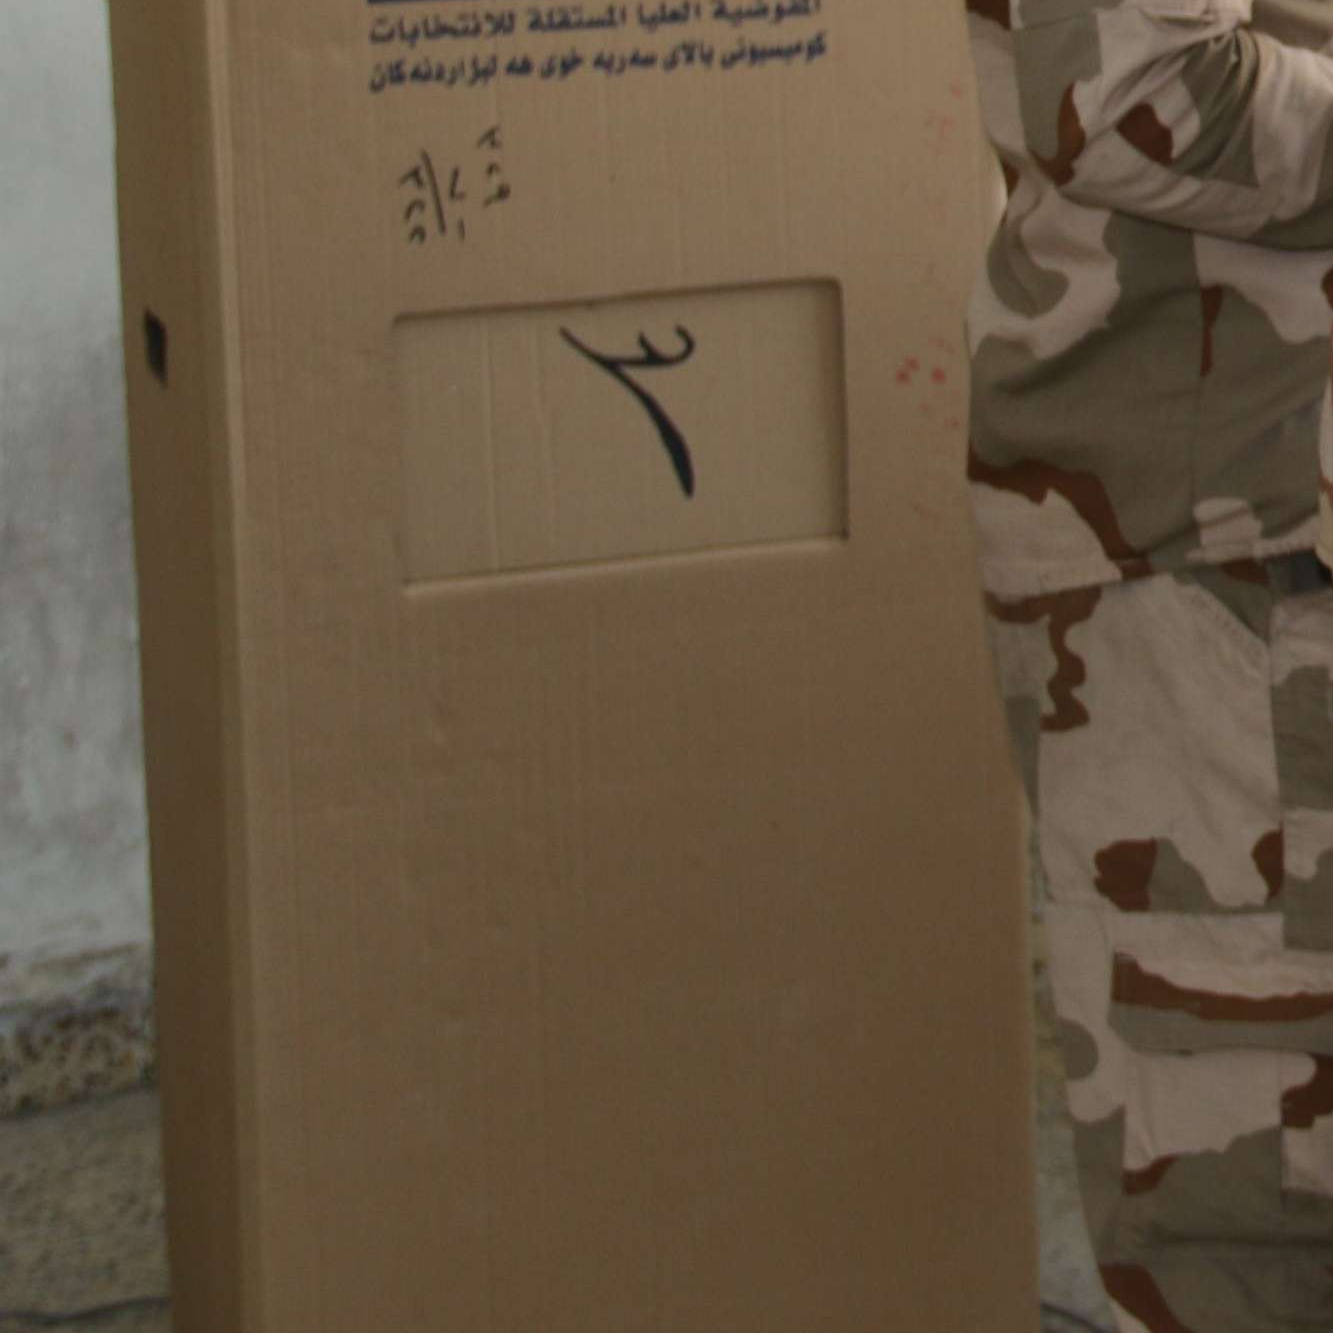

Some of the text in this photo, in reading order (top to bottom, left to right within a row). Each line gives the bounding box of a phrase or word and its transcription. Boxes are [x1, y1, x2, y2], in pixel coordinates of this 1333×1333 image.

[368, 9, 517, 48] للانتخابات
[527, 0, 627, 33] المستقلة
[559, 323, 695, 499] ٣
